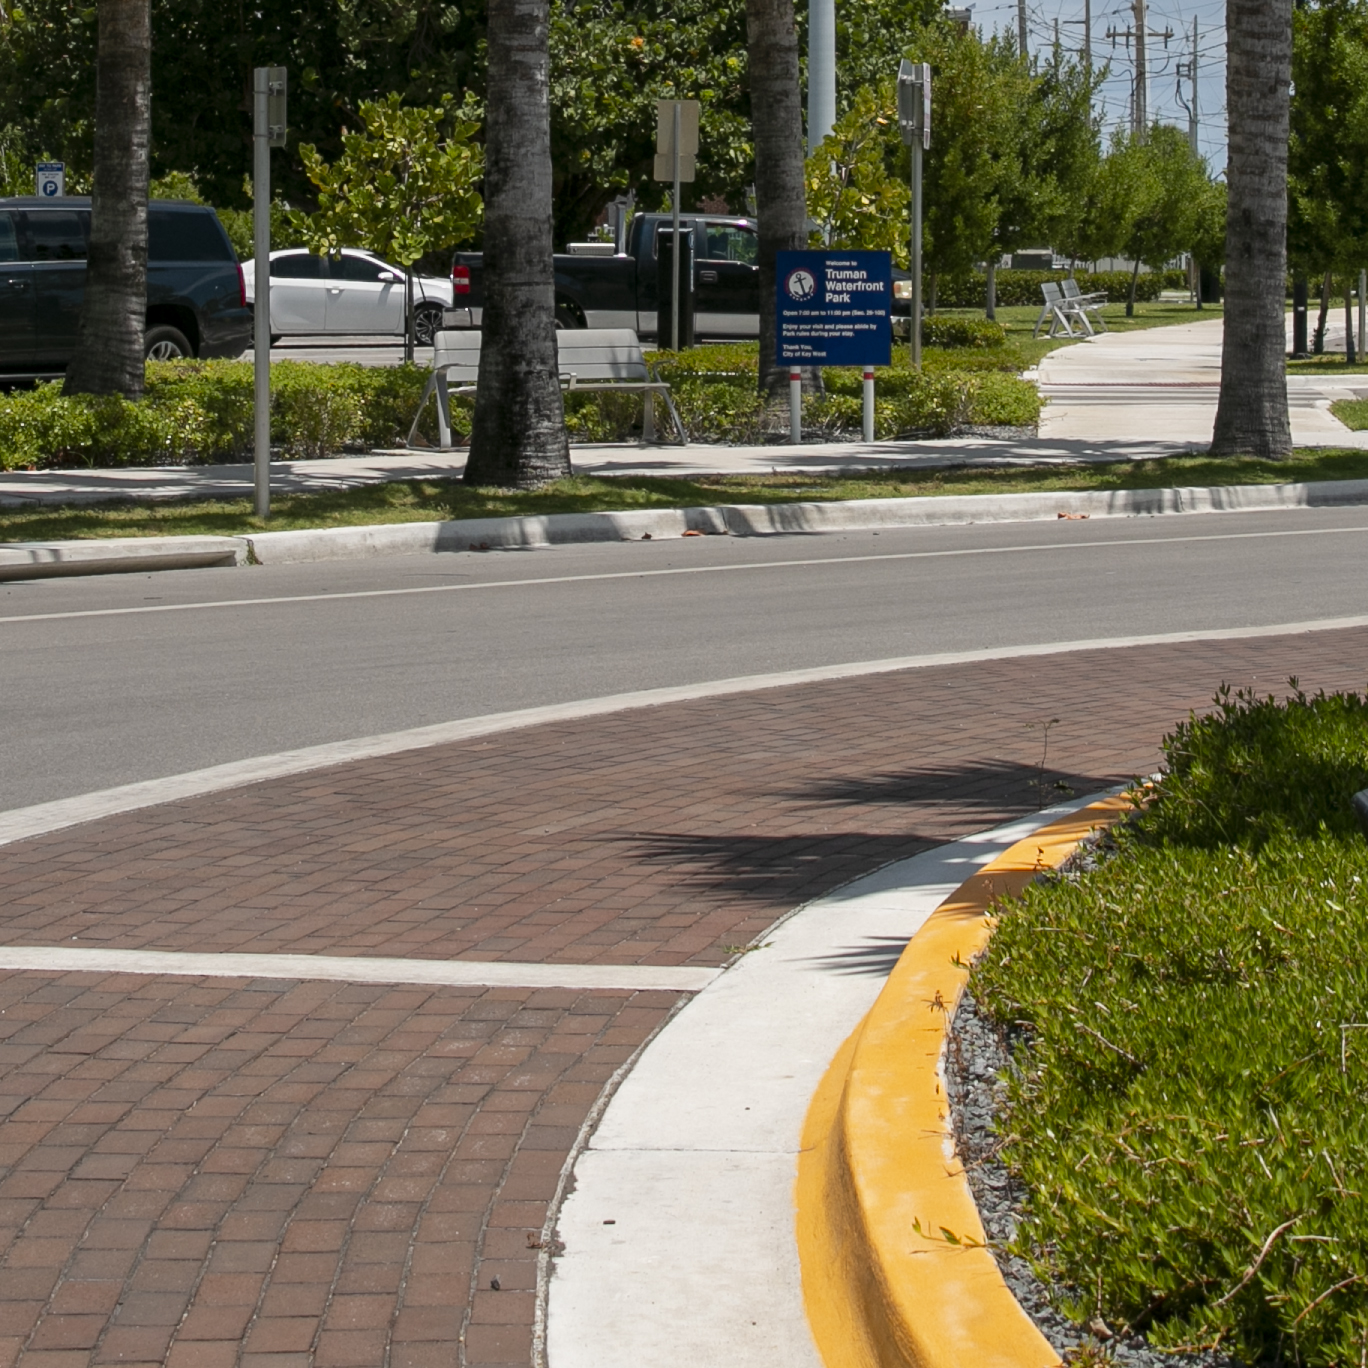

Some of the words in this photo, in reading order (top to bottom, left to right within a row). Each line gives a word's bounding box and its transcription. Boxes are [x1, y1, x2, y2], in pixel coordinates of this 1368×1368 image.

[825, 269, 867, 279] Truman
[825, 281, 884, 291] Waterfront
[825, 293, 851, 303] Park
